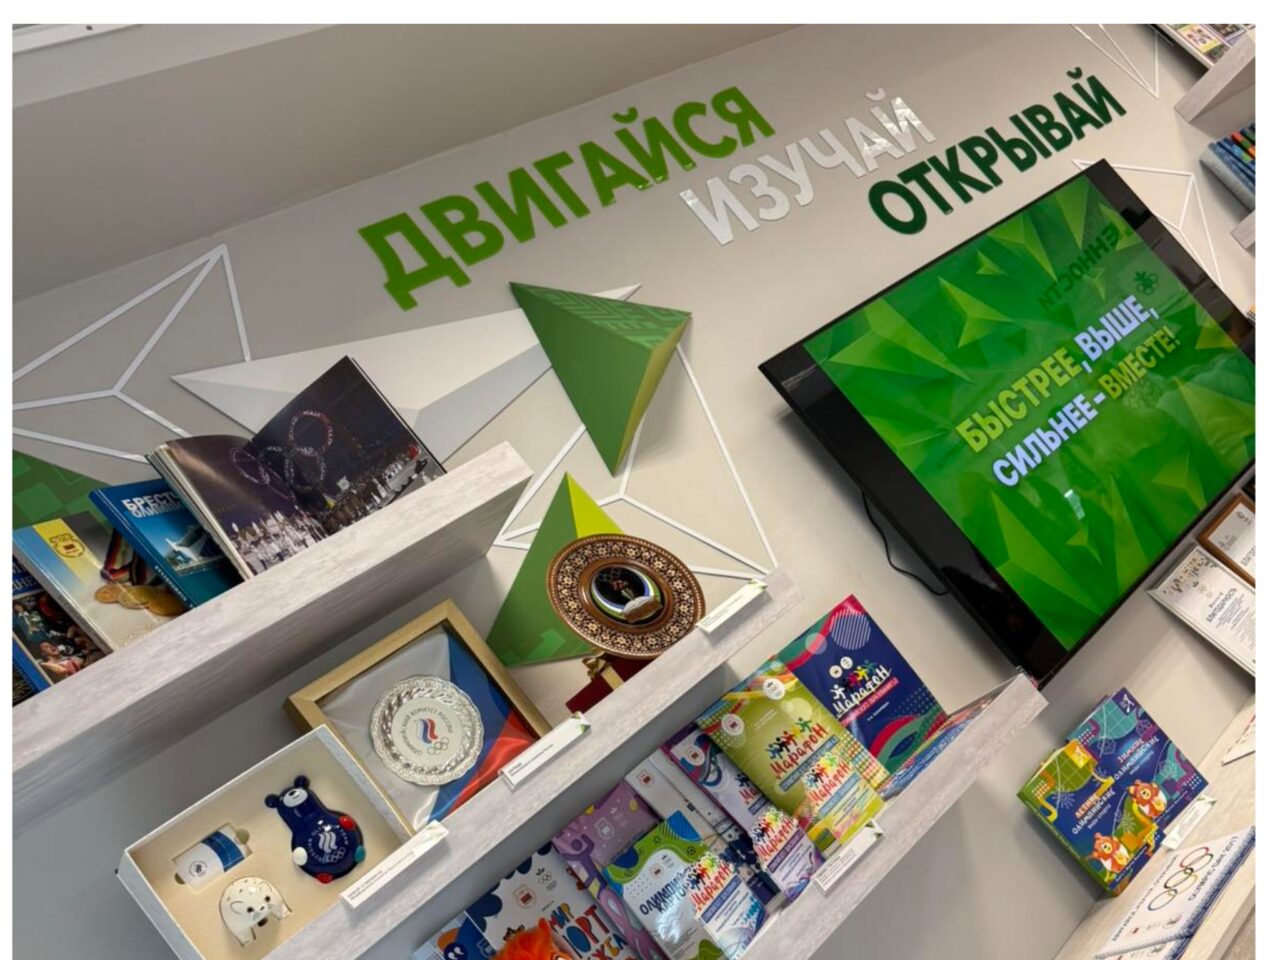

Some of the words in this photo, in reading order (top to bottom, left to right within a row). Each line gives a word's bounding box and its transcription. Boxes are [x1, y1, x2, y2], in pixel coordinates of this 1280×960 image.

[357, 86, 777, 312] ДВИГАЙСЯ
[678, 88, 937, 247] ИЗУЧАЙ
[868, 66, 1128, 236] ОТКРЫВАЙ
[955, 347, 1093, 453] БЫСТРЕЕ,
[1074, 294, 1159, 362] ВЫШЕ,
[992, 393, 1099, 487] СИЛЬНЕЕ
[1098, 325, 1181, 400] ВМЕСТЕ!
[769, 722, 828, 779] Марафон
